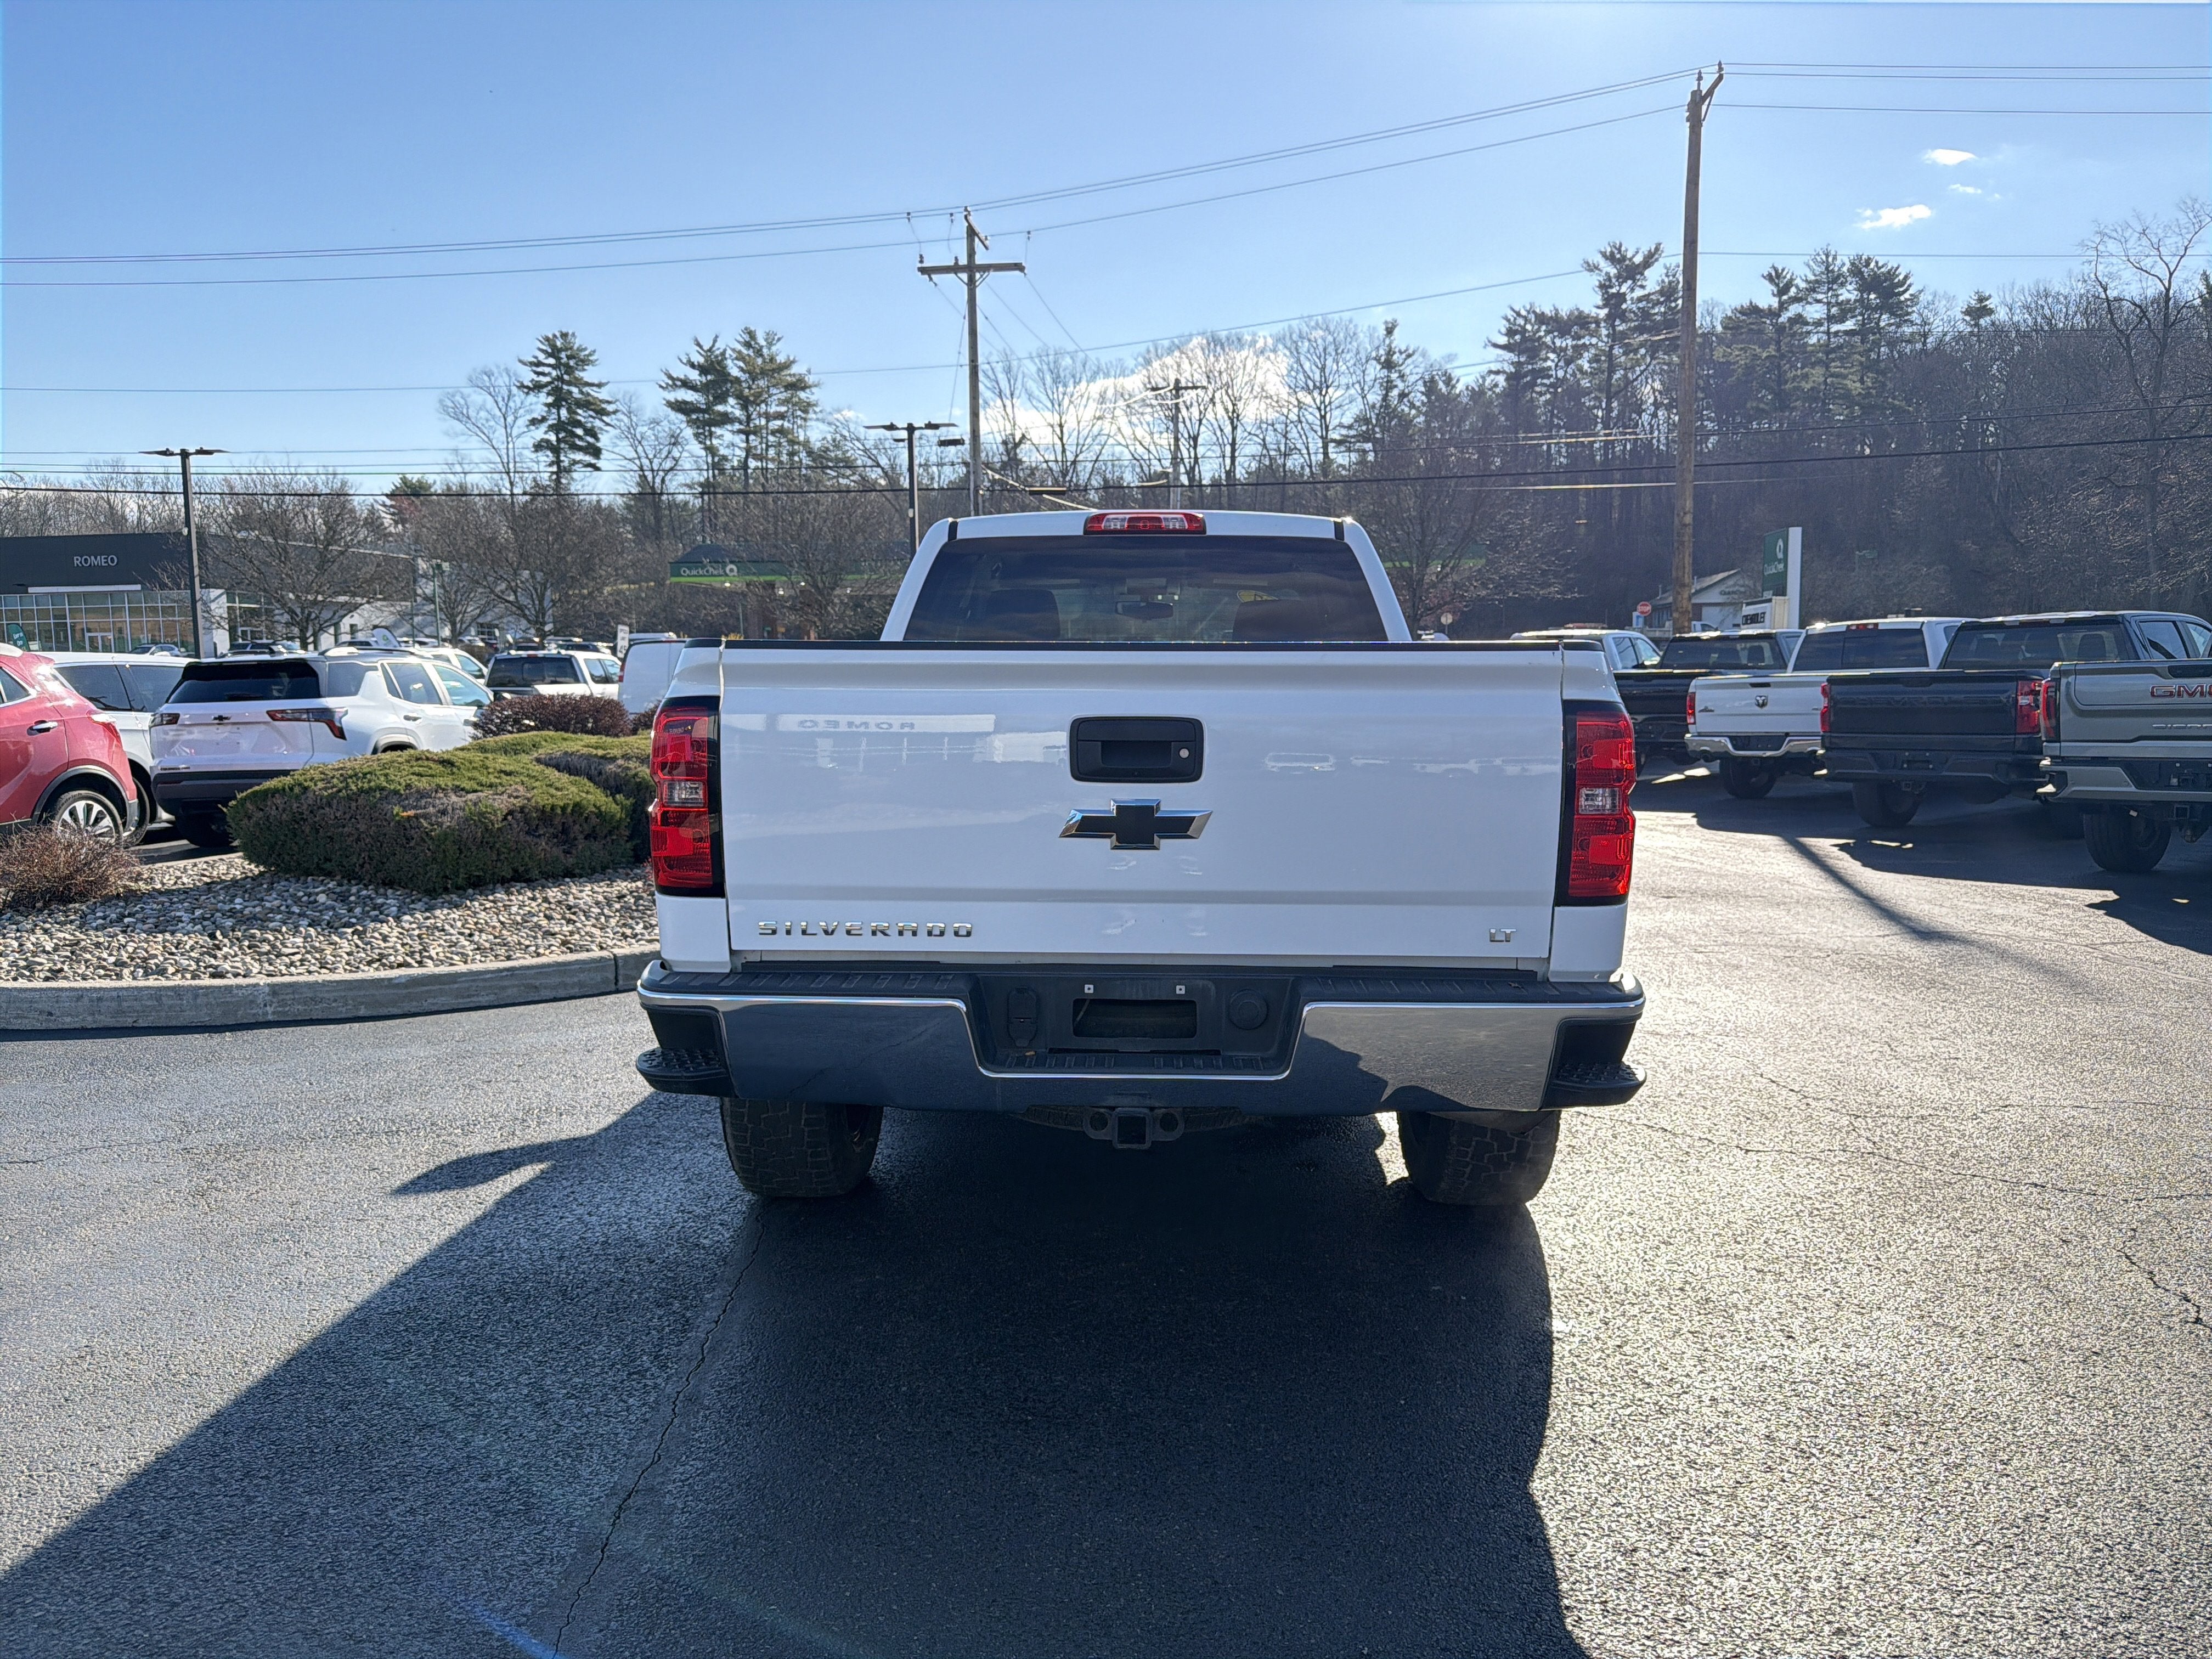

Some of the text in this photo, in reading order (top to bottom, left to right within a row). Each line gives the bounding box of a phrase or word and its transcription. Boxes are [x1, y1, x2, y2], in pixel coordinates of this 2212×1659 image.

[74, 555, 117, 567] ROMEO
[2150, 684, 2212, 698] GM
[758, 921, 973, 938] SILVERADO
[1489, 928, 1517, 943] LT
